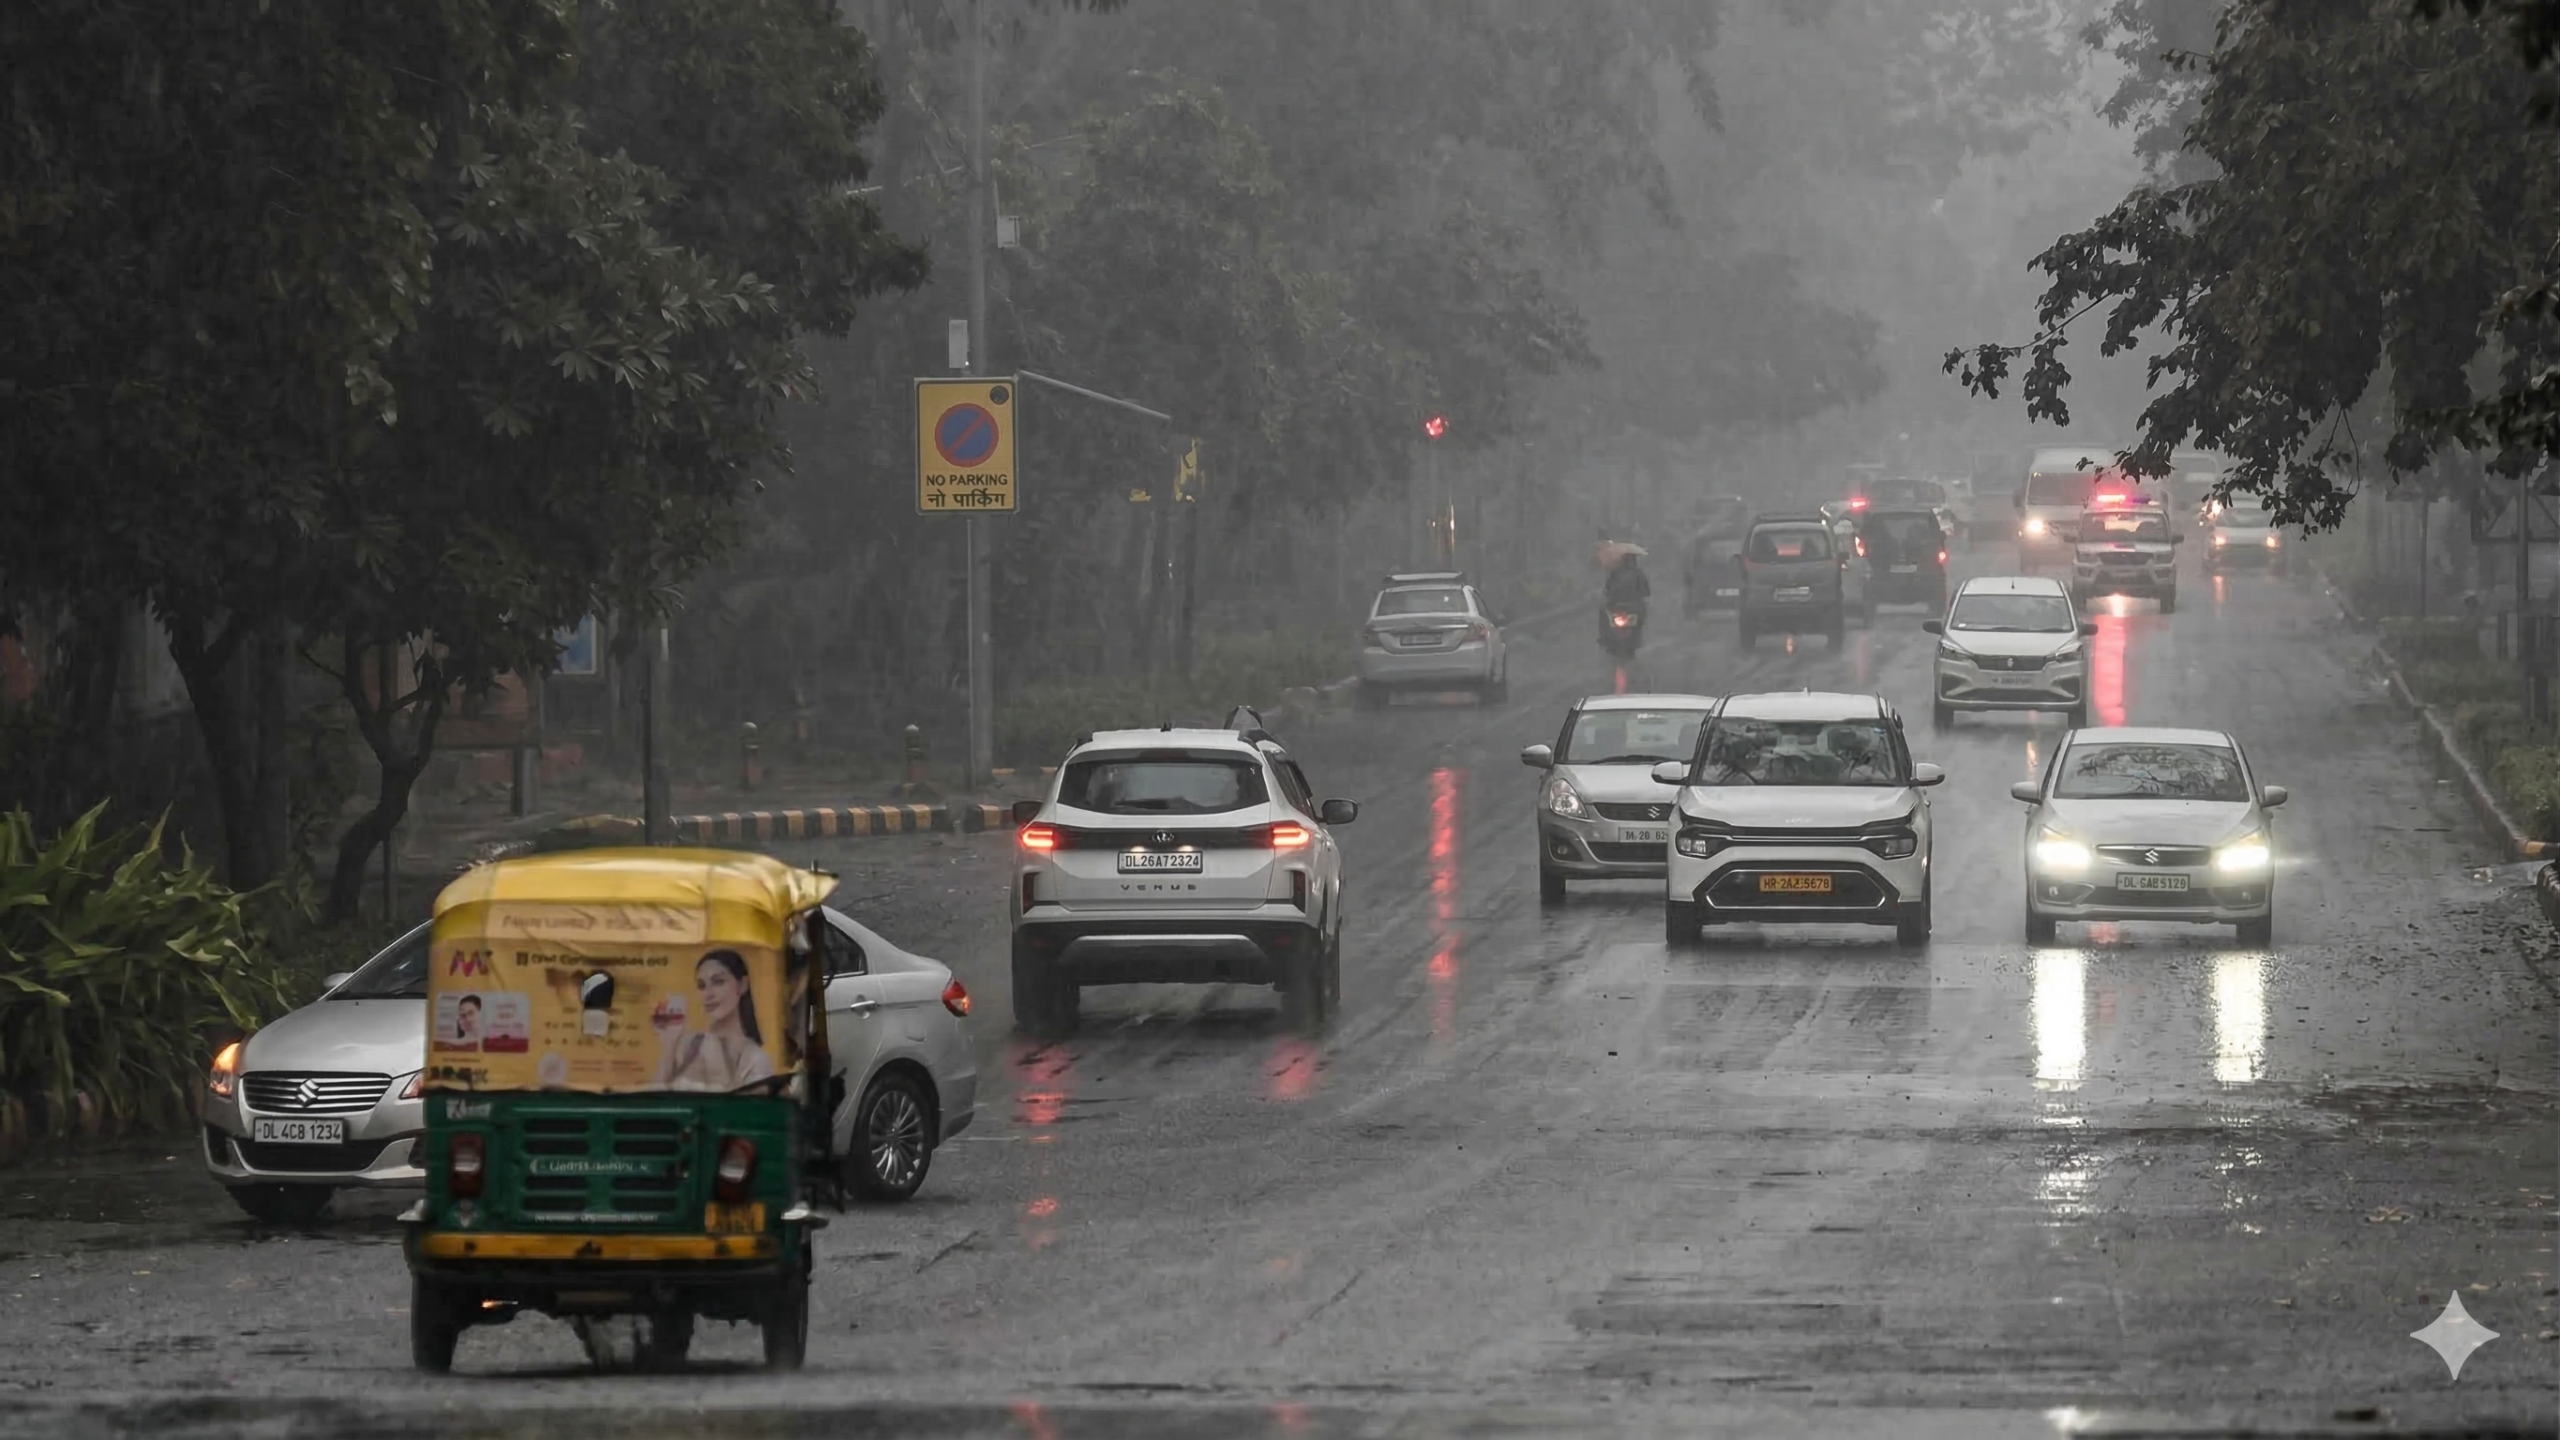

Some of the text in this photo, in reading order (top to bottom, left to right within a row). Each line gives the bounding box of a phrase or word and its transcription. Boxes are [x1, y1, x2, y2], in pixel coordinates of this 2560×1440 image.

[926, 474, 1008, 486] NO PARKING
[926, 488, 946, 507] नो
[263, 1123, 279, 1139] DL
[310, 1123, 341, 1140] 1234
